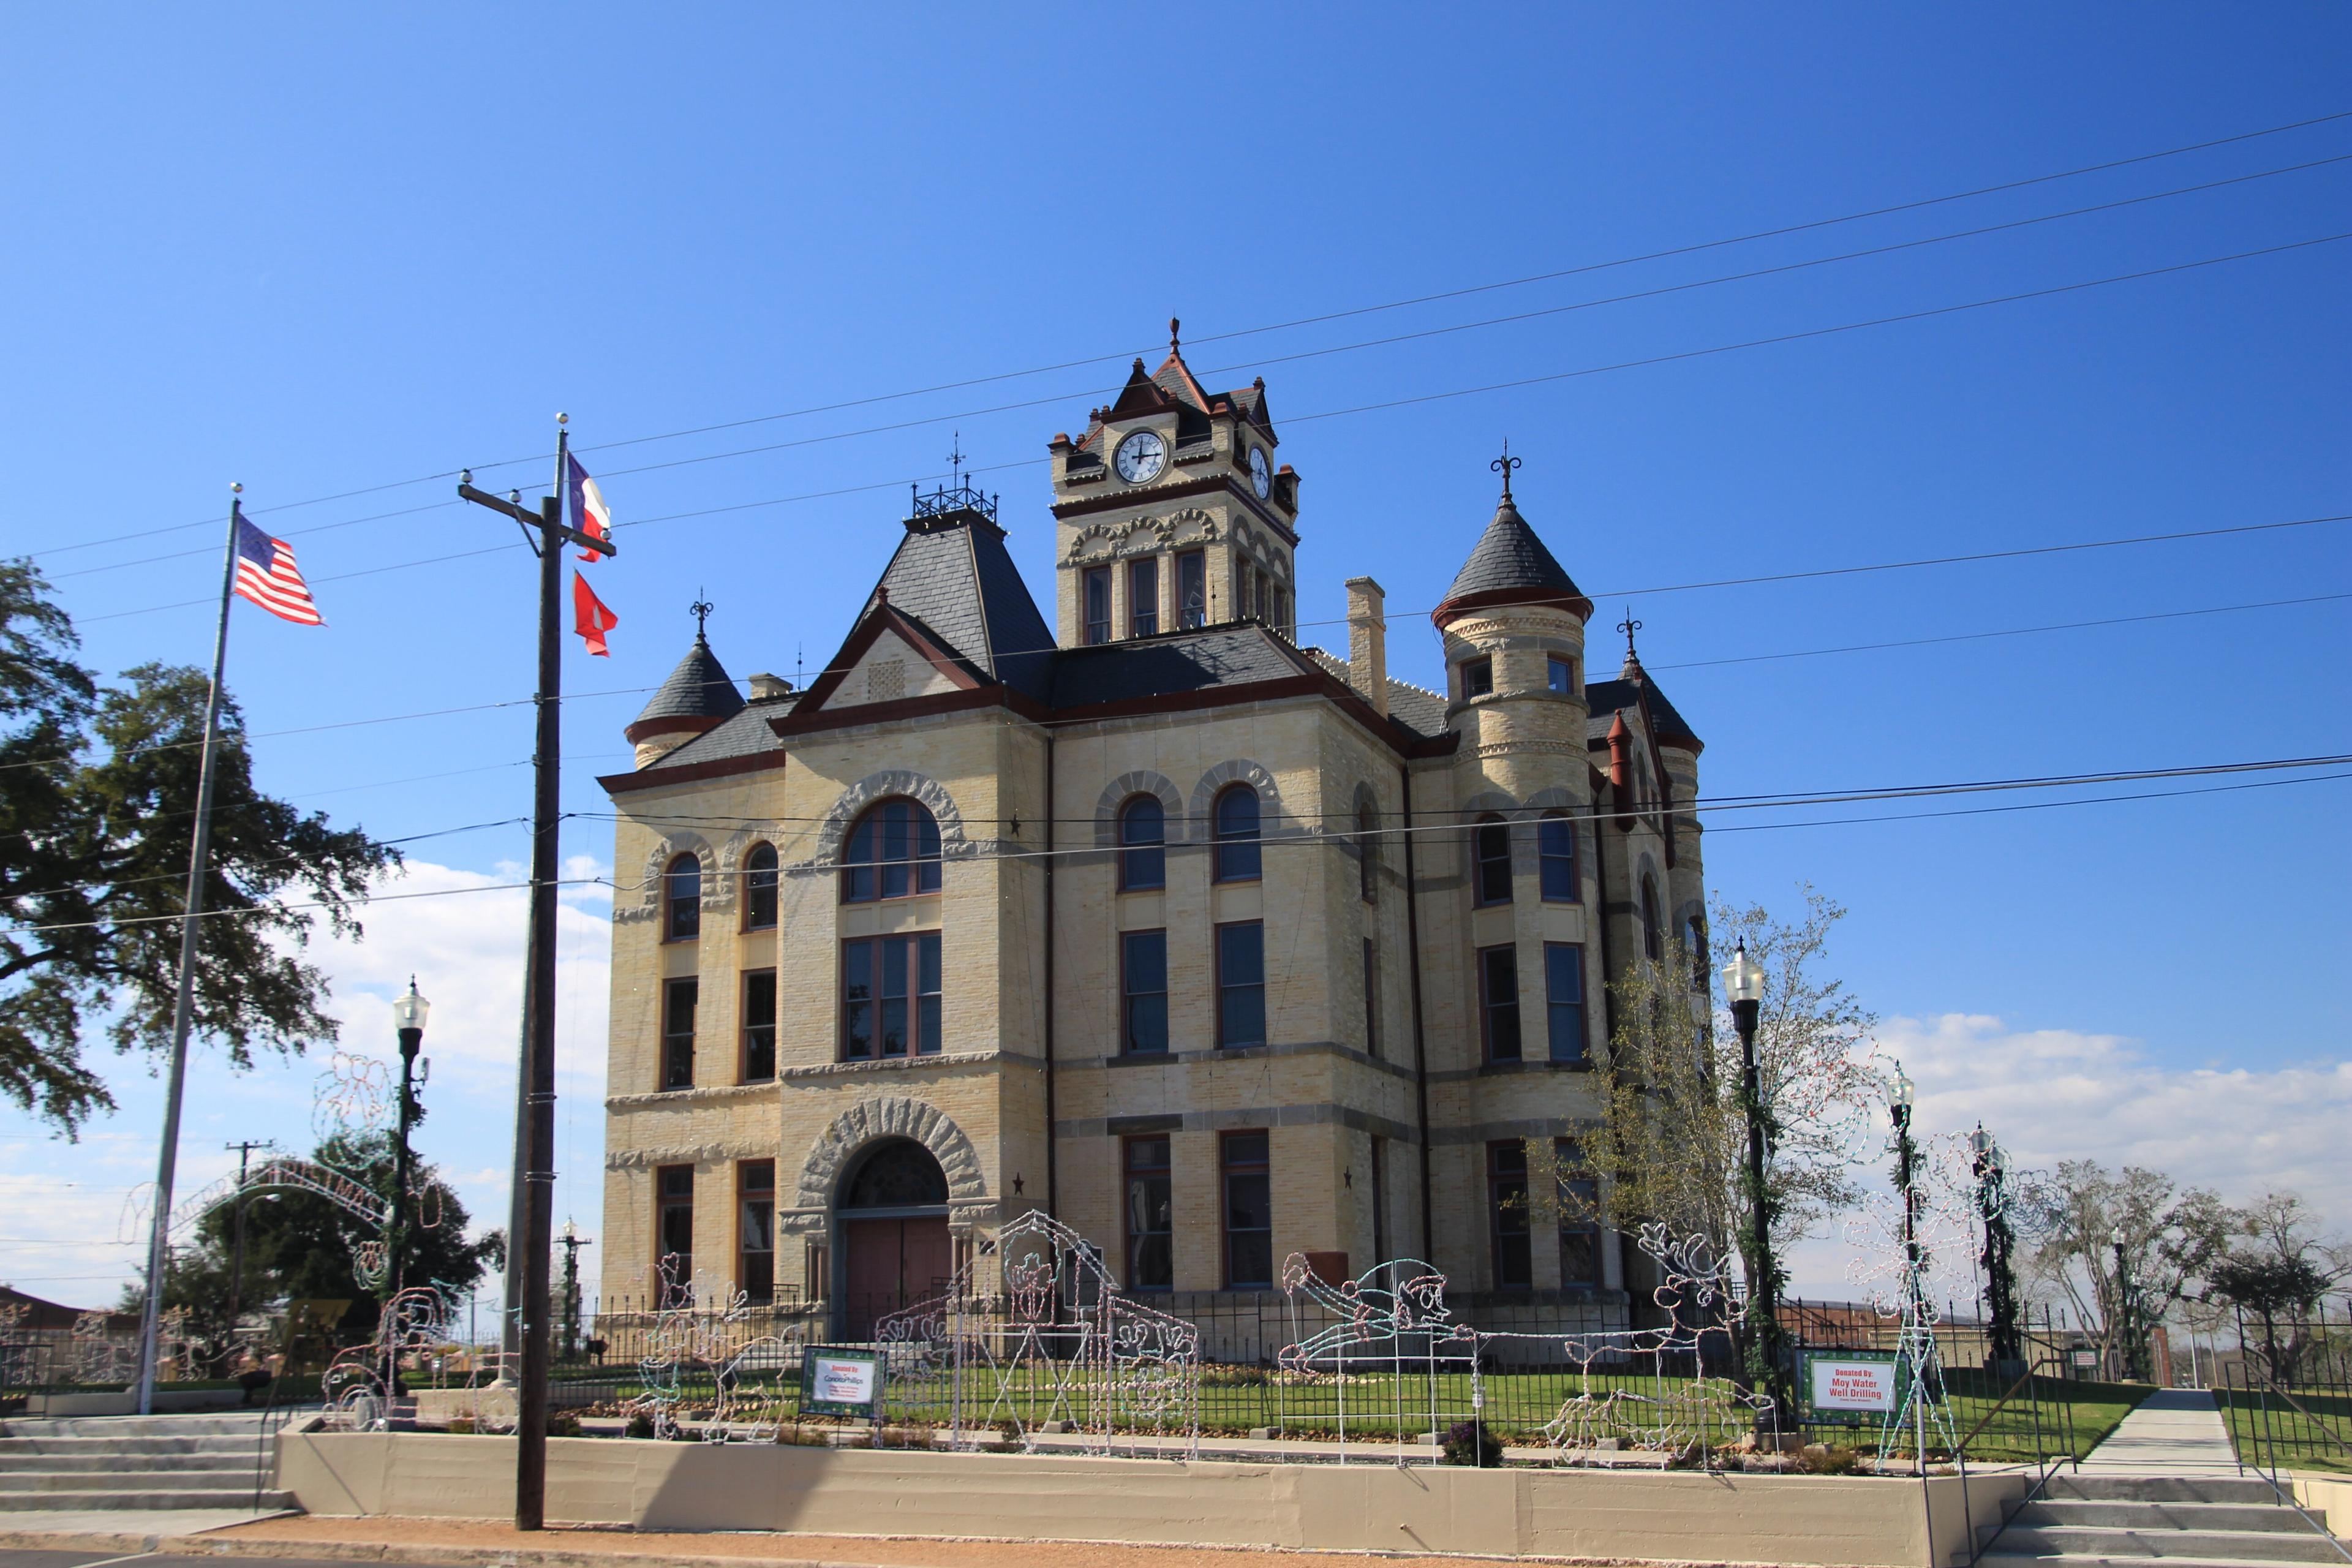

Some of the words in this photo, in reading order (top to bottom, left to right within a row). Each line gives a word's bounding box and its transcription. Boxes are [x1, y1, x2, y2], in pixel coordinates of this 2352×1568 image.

[824, 1374, 863, 1384] ConocoPhillips
[1832, 1378, 1850, 1388] Moy
[1852, 1379, 1877, 1388] Water
[1829, 1388, 1848, 1396] Well
[1850, 1389, 1882, 1400] Drilling
